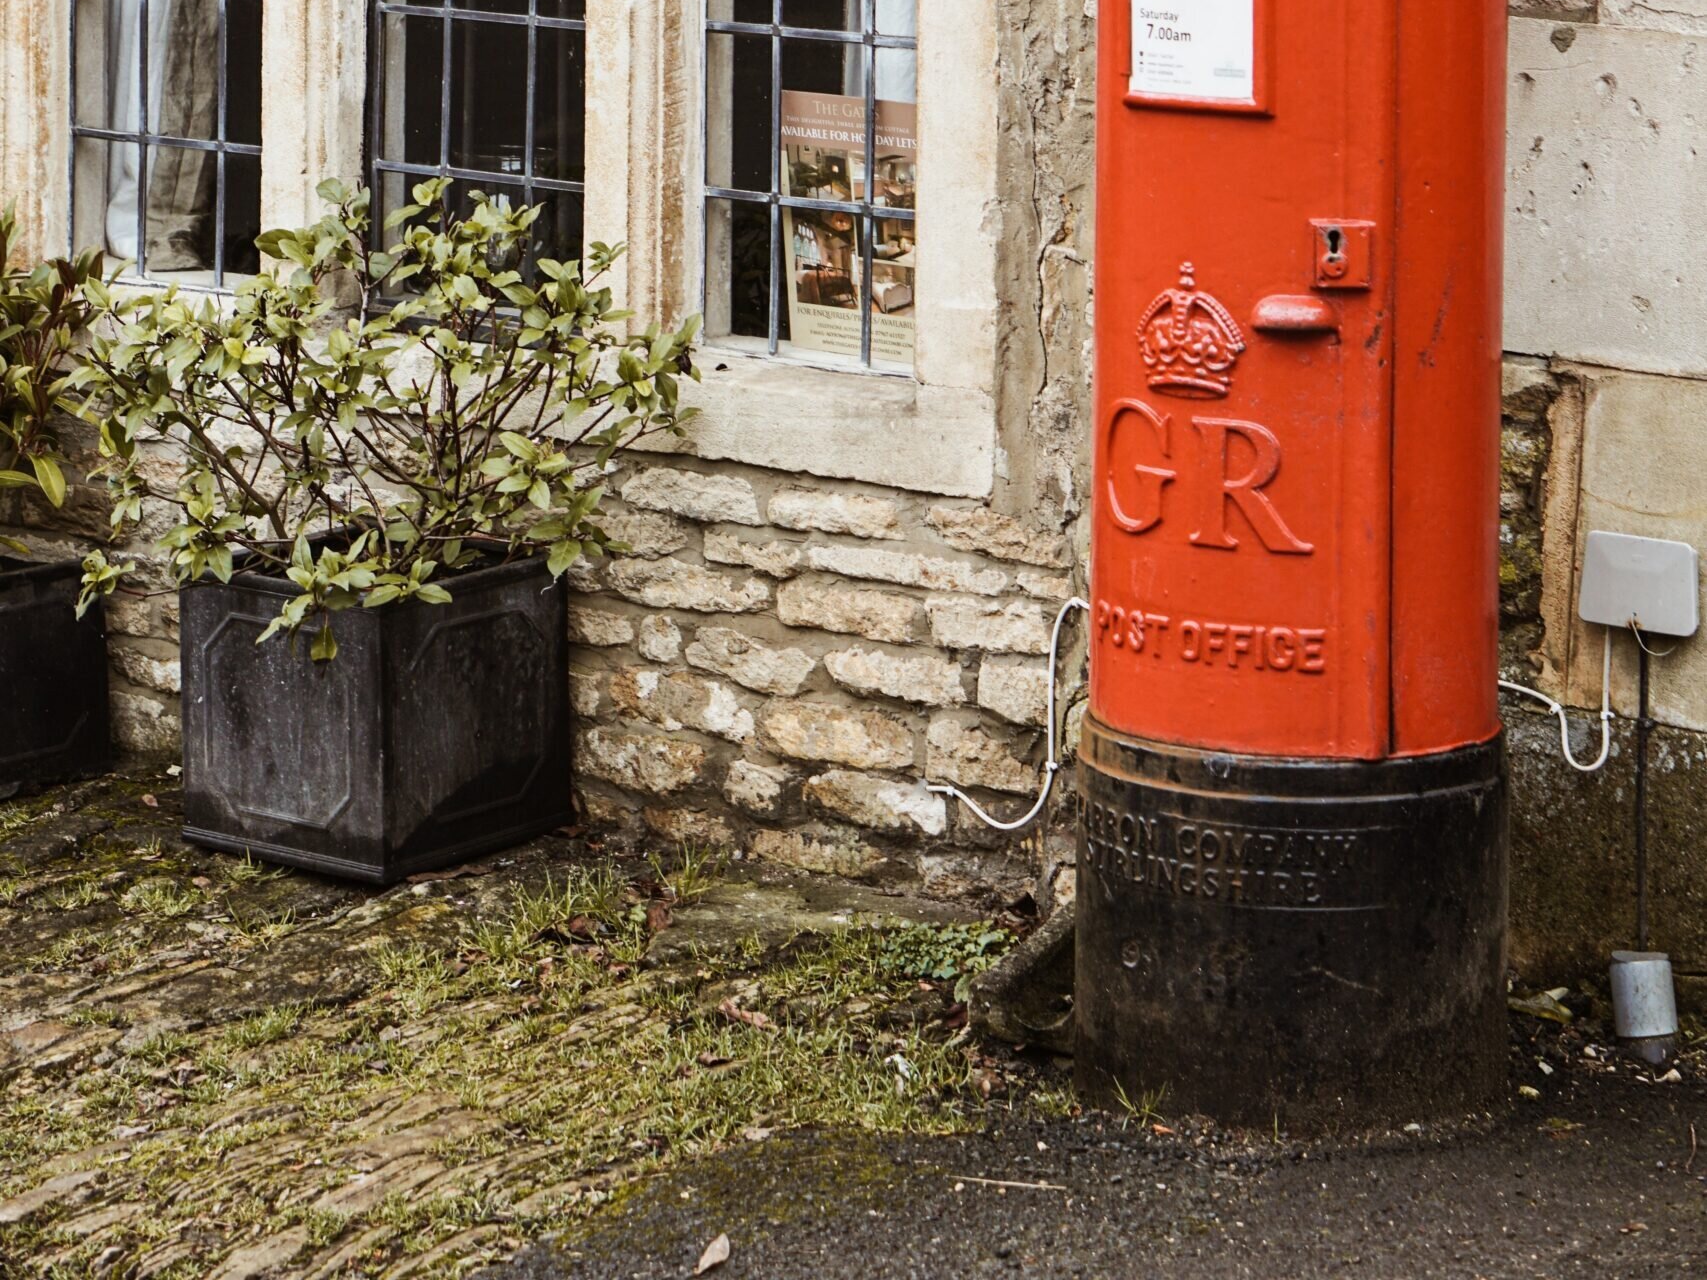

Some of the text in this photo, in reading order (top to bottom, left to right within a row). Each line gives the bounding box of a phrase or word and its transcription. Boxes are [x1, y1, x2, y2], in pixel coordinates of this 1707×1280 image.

[1139, 7, 1180, 23] Saturday
[1146, 23, 1192, 42] 7.00am
[812, 100, 880, 120] THE GATS
[781, 125, 918, 150] AVAILABLE FOR HODAY LETS
[796, 306, 812, 317] FOR
[1106, 396, 1315, 556] GR
[1097, 598, 1327, 675] POST OFFICE
[1177, 824, 1358, 870] COMPANY
[1085, 837, 1322, 904] STIRLINGSHIRE
